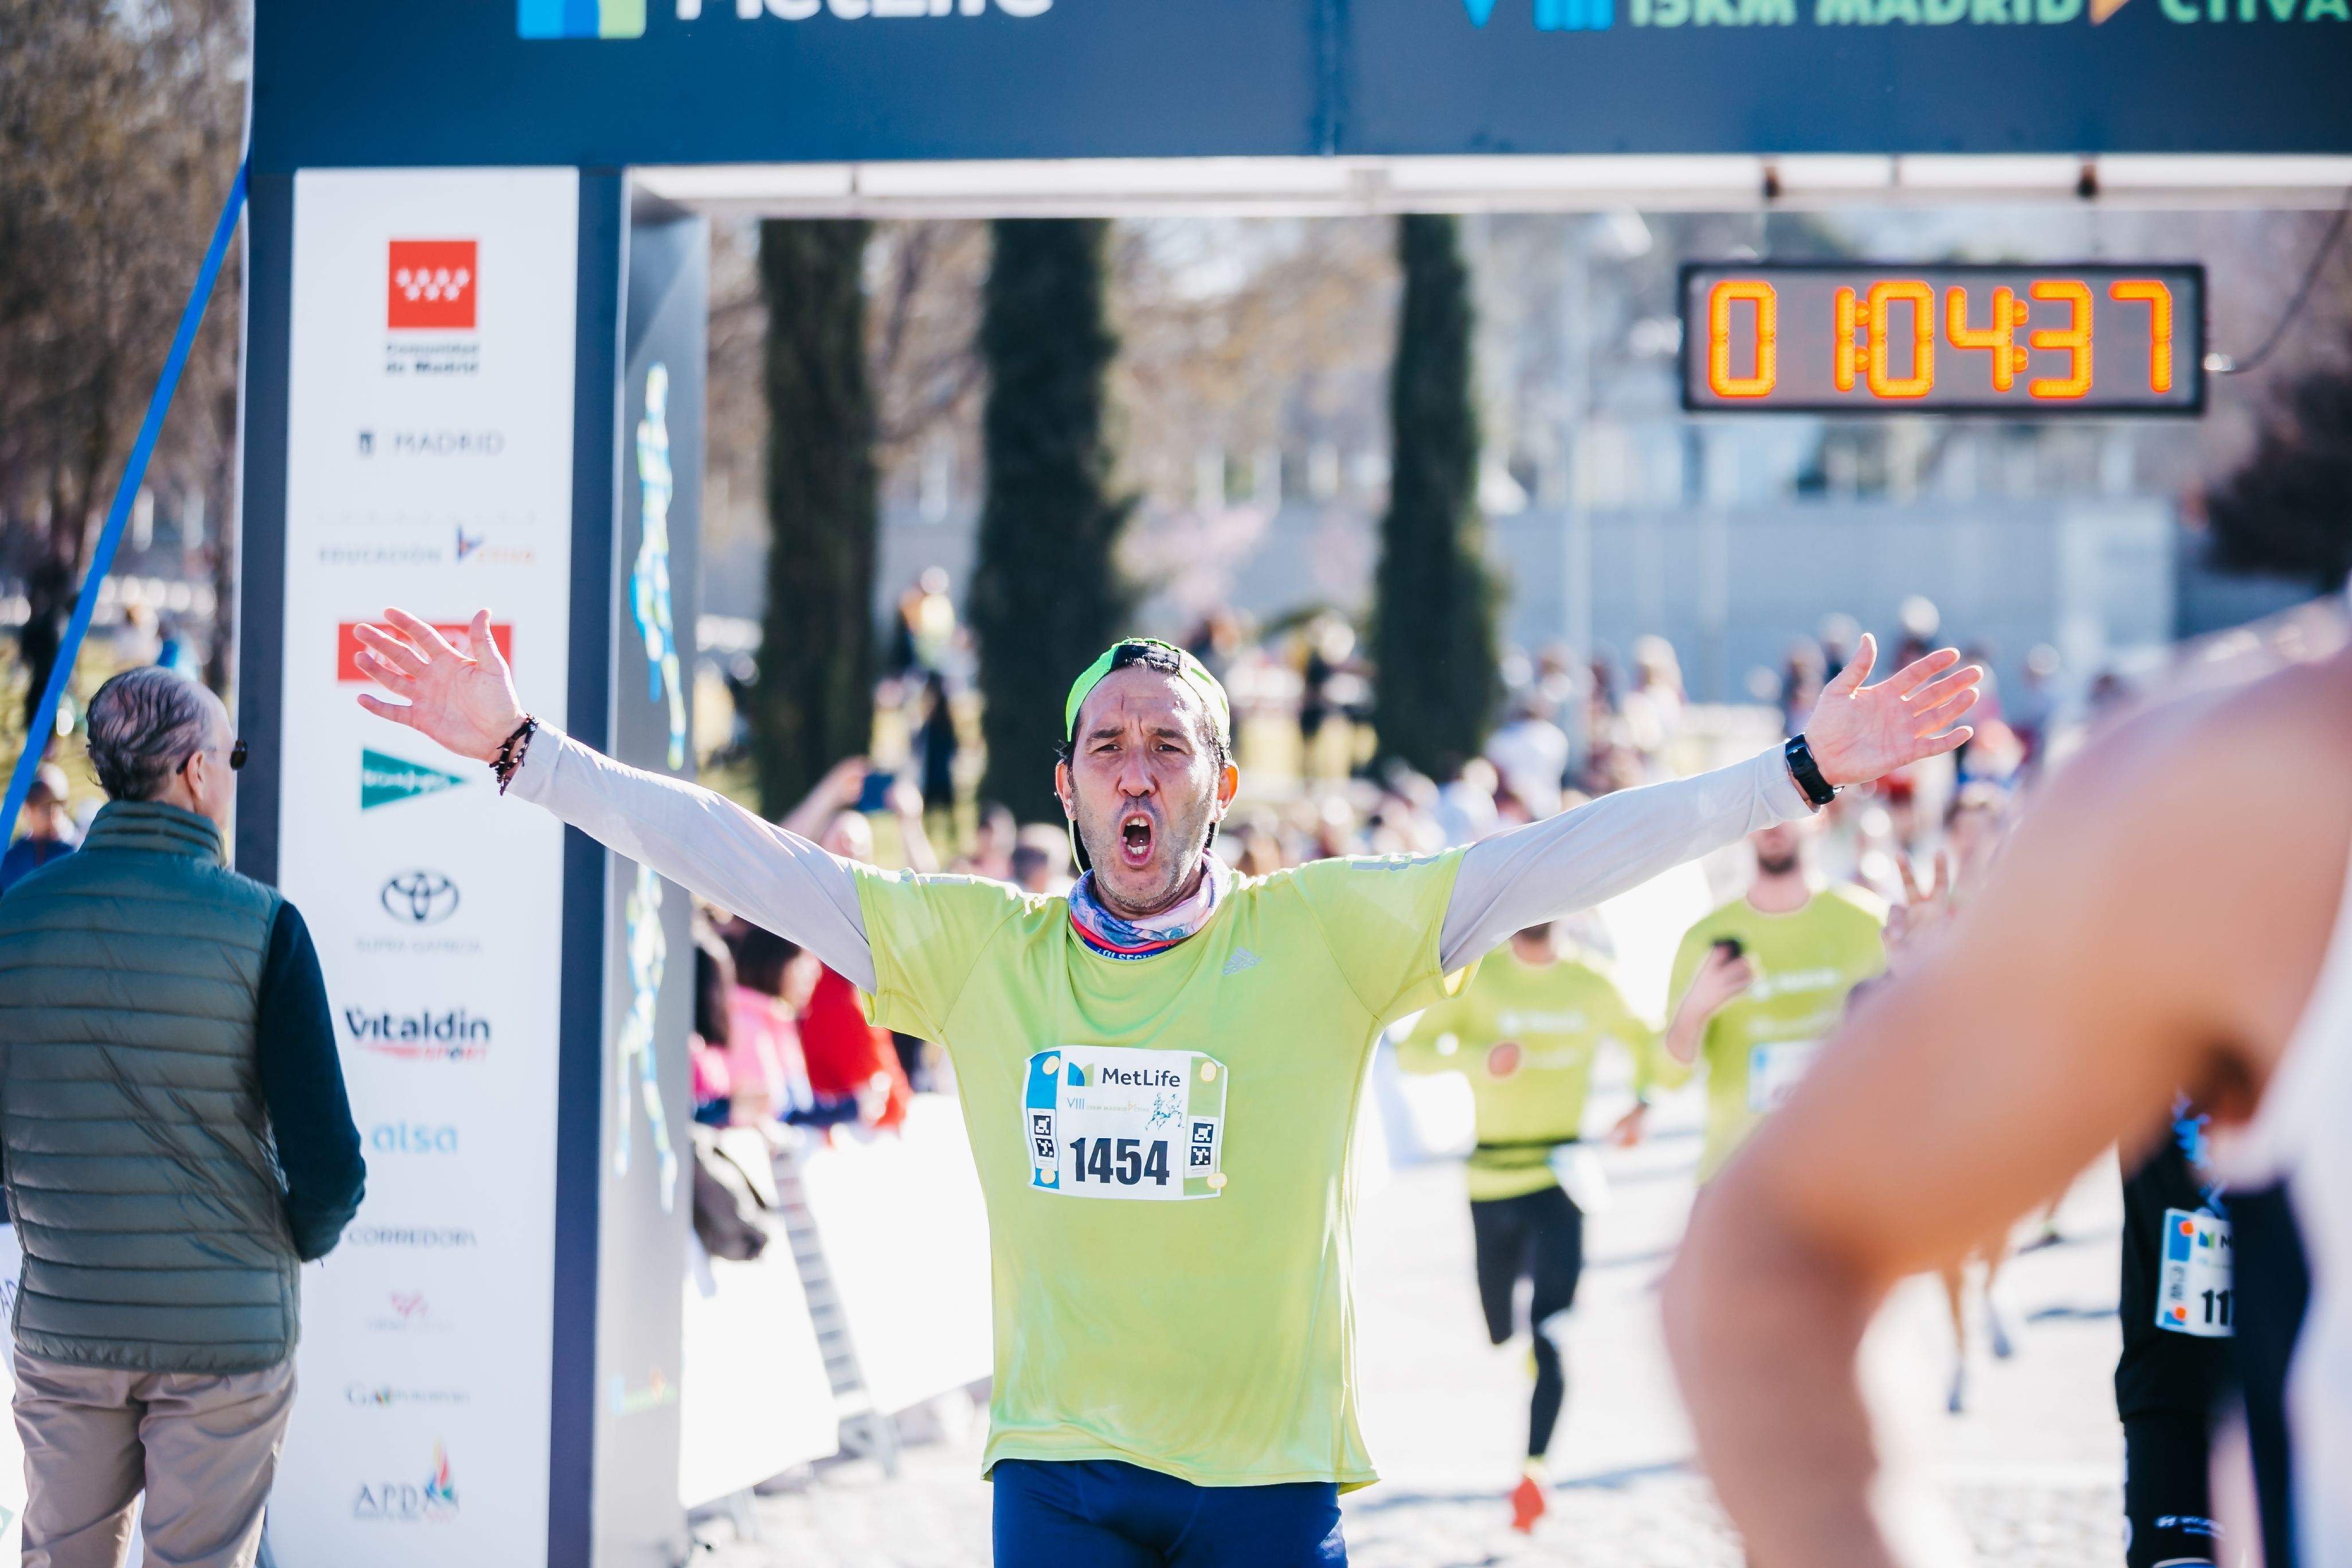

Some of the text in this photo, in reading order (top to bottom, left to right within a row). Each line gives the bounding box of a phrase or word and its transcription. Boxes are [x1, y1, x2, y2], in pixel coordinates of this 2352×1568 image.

[344, 1009, 490, 1039] Vitaldin
[1101, 1067, 1181, 1087] MetLife
[1067, 1097, 1085, 1110] VIII
[371, 1119, 458, 1153] alsa
[1069, 1136, 1170, 1186] 1454
